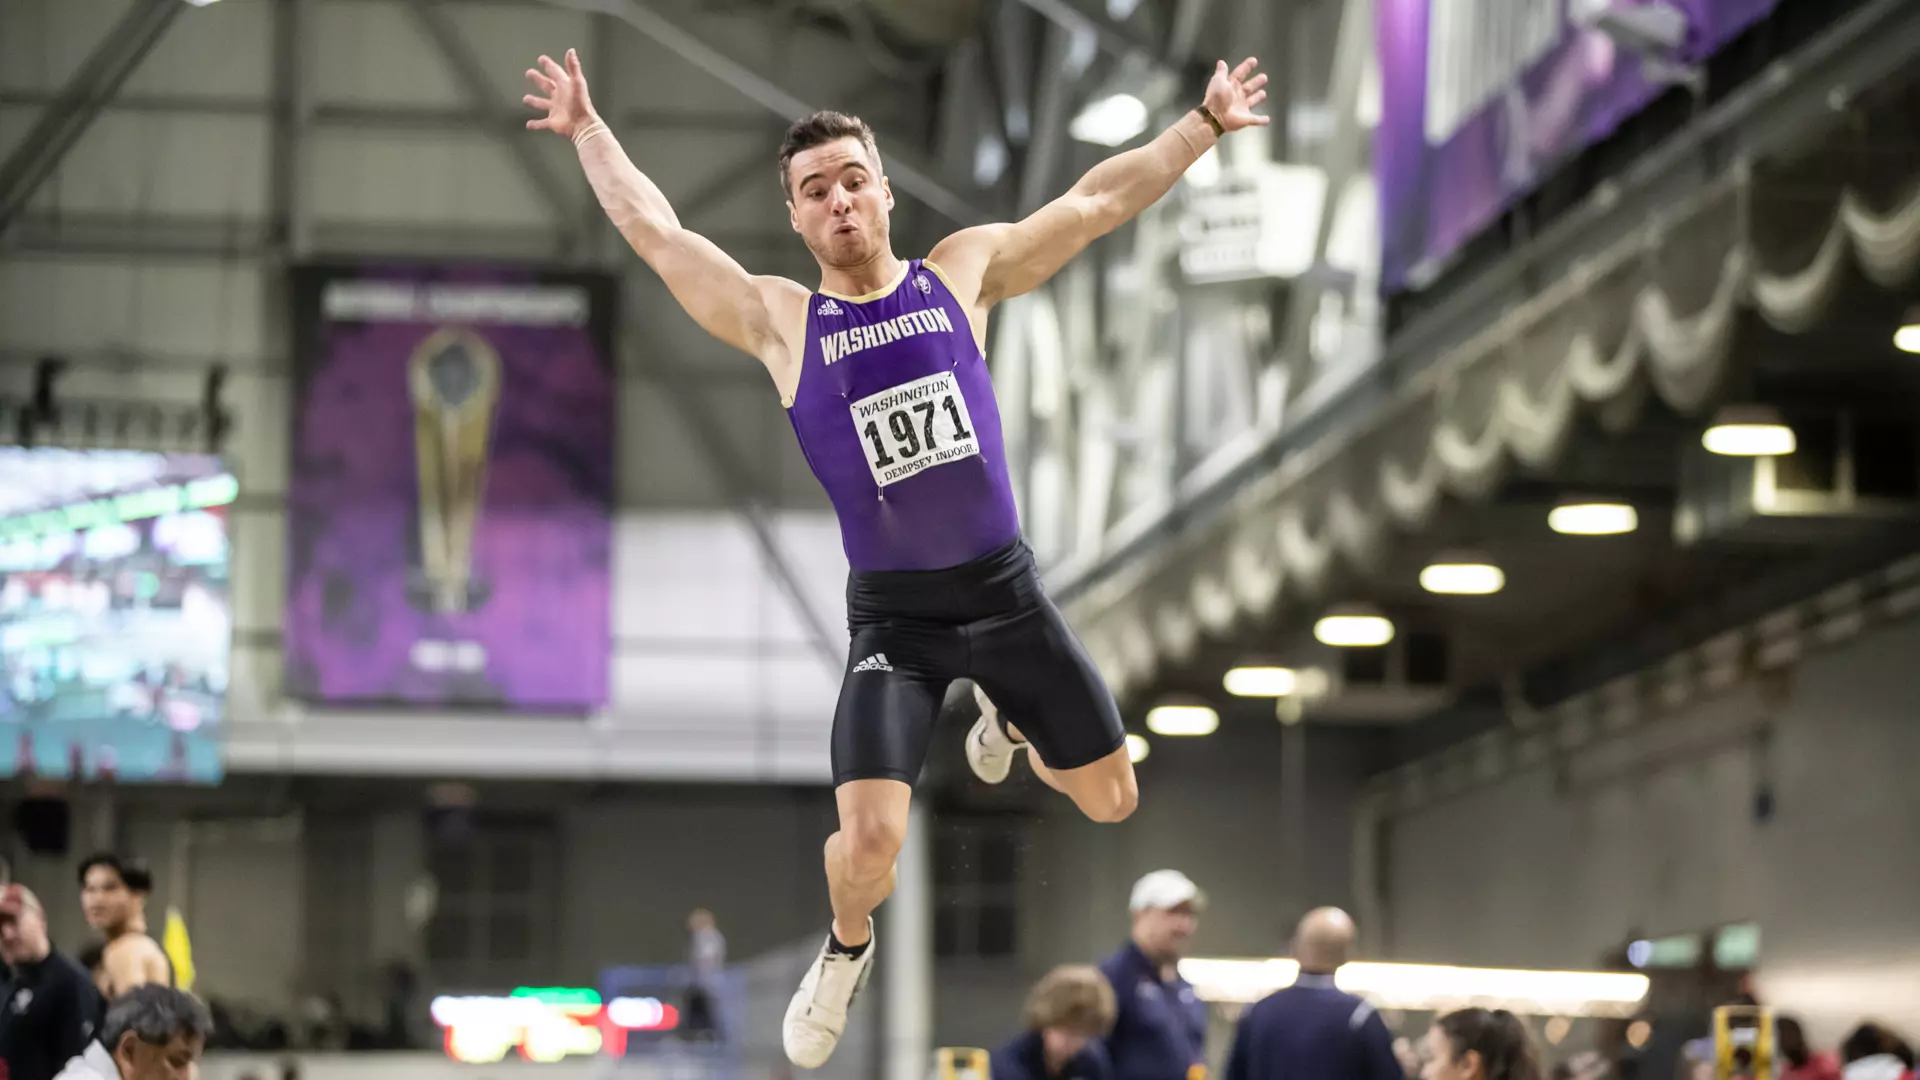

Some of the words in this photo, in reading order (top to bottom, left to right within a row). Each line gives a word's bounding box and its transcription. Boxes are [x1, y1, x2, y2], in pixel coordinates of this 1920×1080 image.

[820, 307, 954, 366] WASHINGTON
[859, 380, 950, 418] WASHINGTON
[864, 395, 971, 470] 1971
[884, 455, 933, 481] DEMPSEY
[936, 443, 974, 461] INDOOR
[853, 662, 893, 672] adidas
